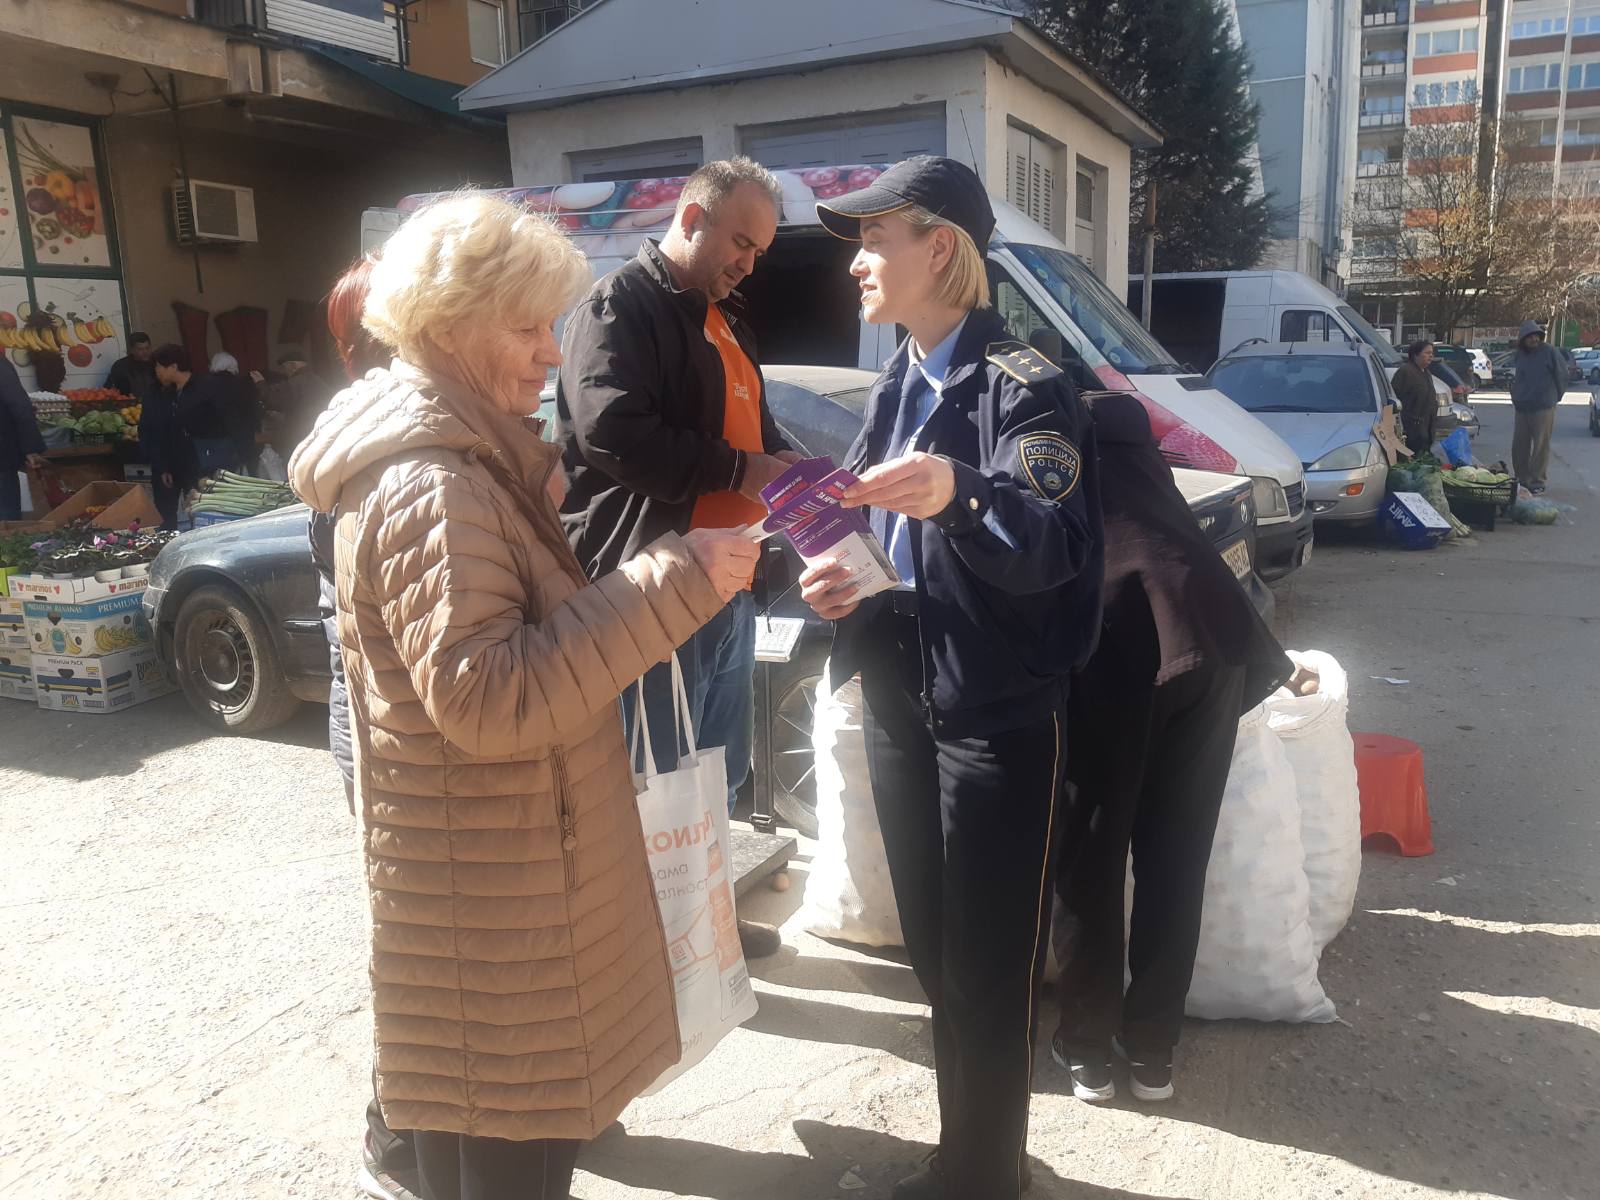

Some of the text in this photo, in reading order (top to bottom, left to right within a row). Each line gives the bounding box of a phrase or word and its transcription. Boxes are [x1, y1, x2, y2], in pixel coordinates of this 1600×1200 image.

[1026, 446, 1076, 468] ПОЛИЦИЈА
[1028, 459, 1074, 478] POLICE
[25, 583, 52, 594] marinos
